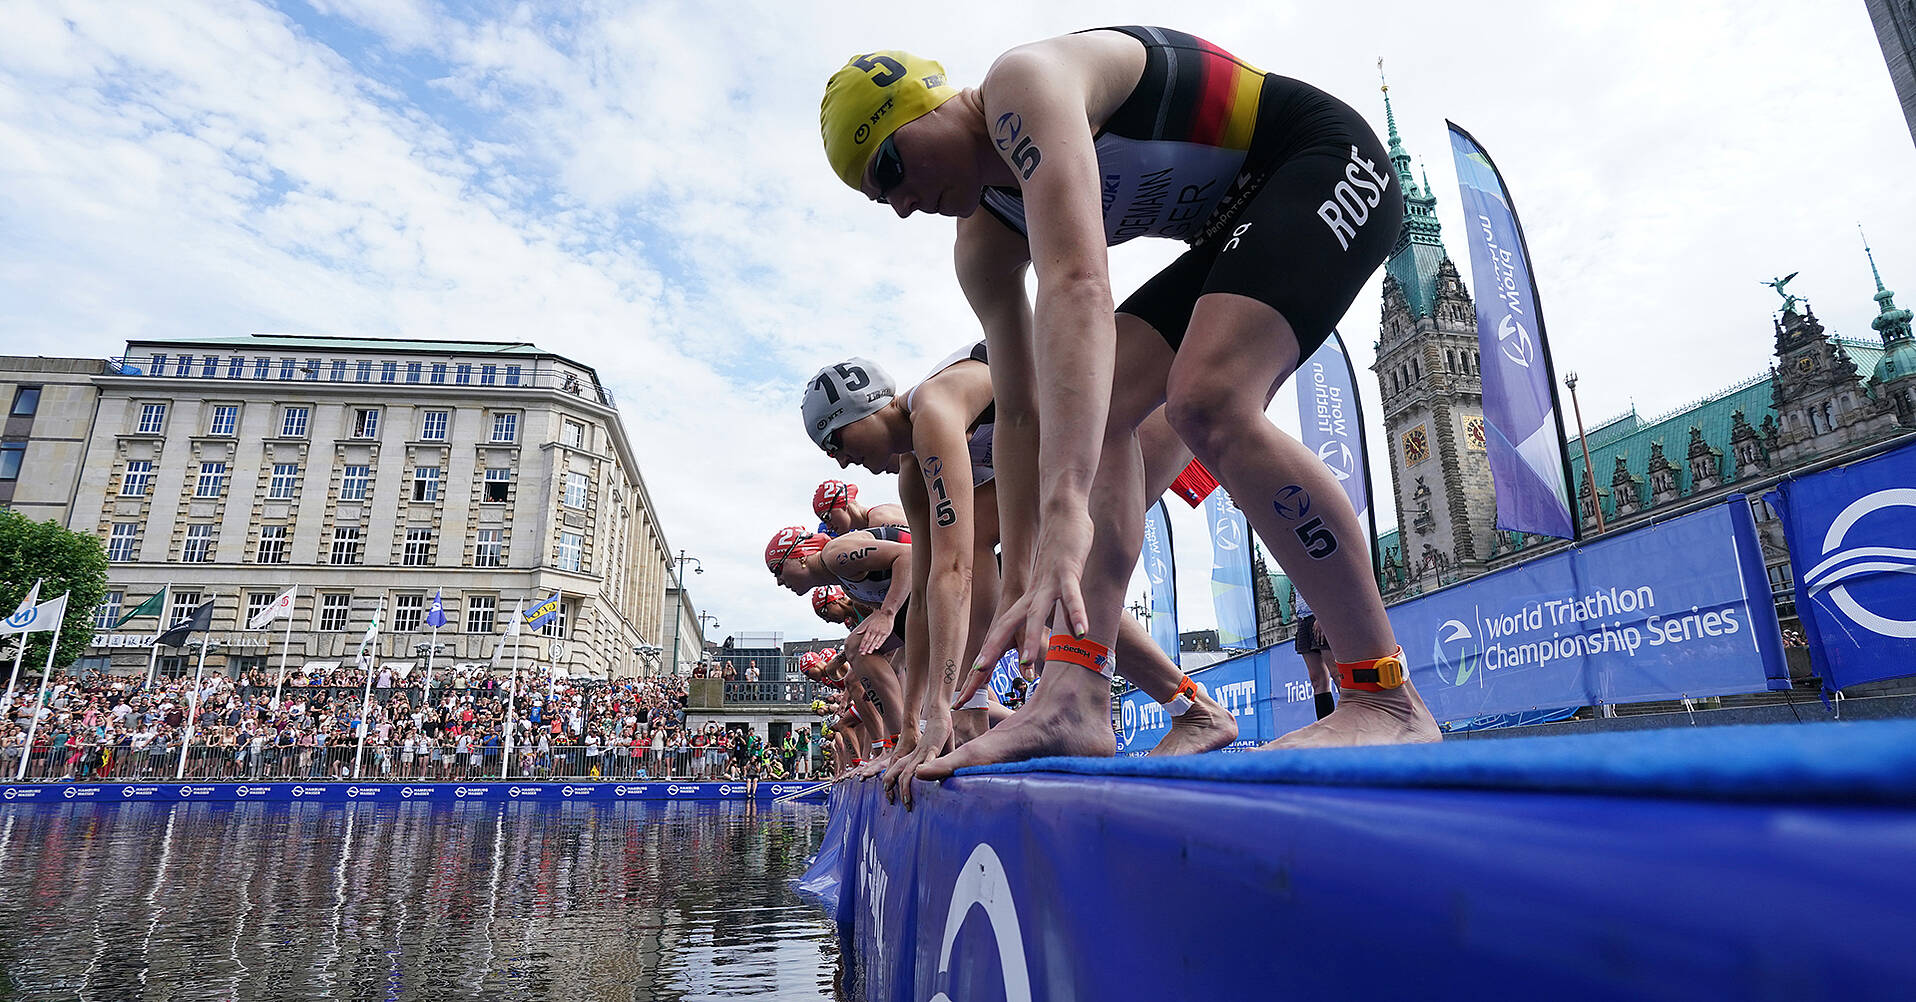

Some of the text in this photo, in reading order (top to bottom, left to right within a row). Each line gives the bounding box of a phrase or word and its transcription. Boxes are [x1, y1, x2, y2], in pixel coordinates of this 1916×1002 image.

[852, 54, 907, 88] 5
[870, 98, 895, 126] NTT
[1010, 136, 1041, 183] 5
[1317, 145, 1390, 252] ROSE
[1293, 514, 1339, 561] 5
[1485, 586, 1655, 640] World Triathlon
[1484, 606, 1740, 671] Championship Series
[1215, 681, 1256, 717] NTT
[1285, 680, 1314, 703] Triat
[1139, 702, 1165, 732] NTT
